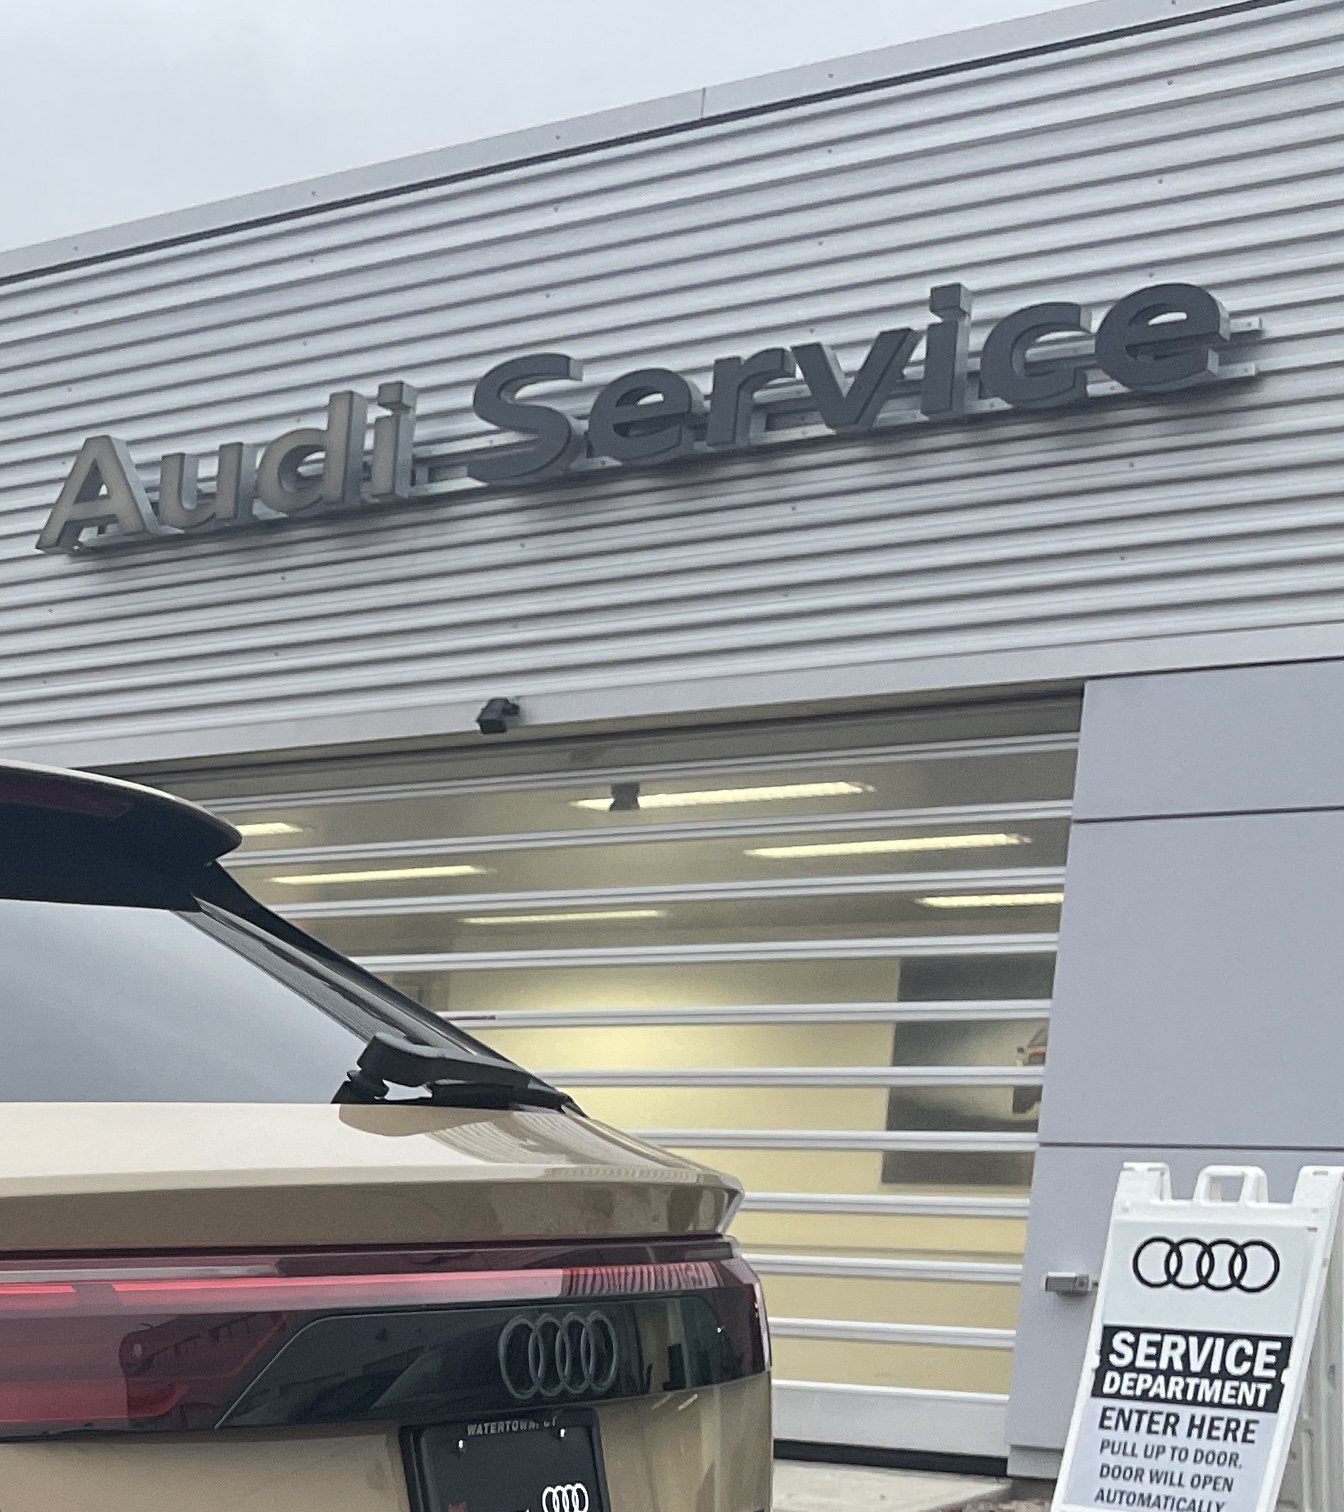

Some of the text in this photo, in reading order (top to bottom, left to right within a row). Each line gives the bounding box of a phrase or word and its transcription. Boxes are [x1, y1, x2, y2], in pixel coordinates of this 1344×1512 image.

[36, 282, 1232, 553] Audi Service
[1109, 1330, 1282, 1379] SERVICE
[1102, 1370, 1273, 1407] DEPARTMENT
[1098, 1405, 1260, 1444] ENTER HERE
[1100, 1438, 1243, 1470] PULL UP TO DOOR.
[1099, 1463, 1234, 1493] DOOR WILL OPEN
